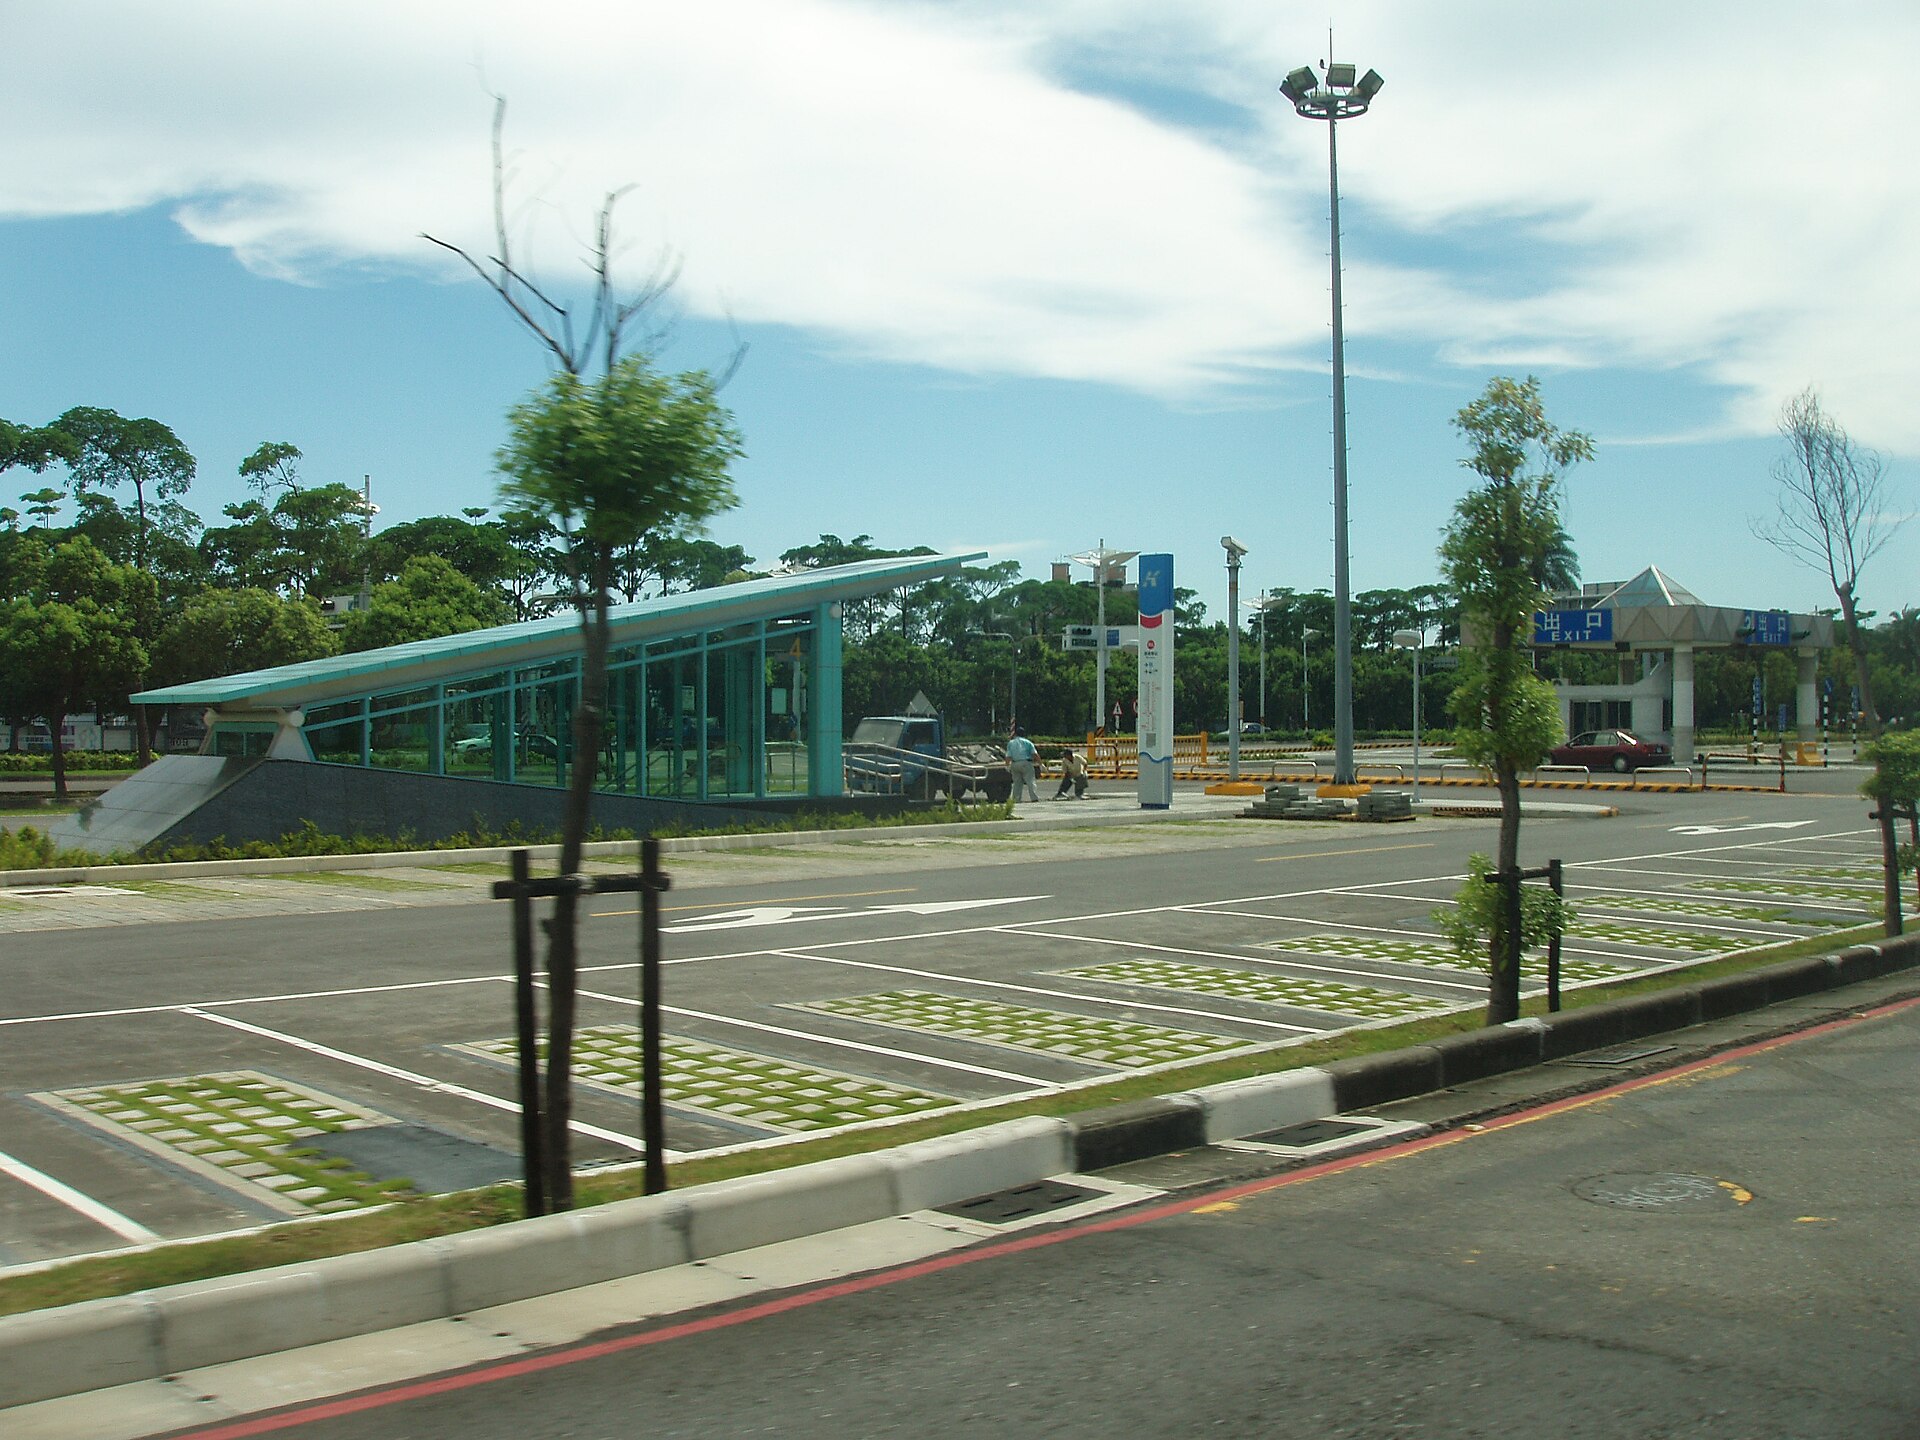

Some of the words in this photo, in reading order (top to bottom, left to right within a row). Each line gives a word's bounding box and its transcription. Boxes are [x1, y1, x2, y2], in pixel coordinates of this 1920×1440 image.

[1544, 612, 1602, 631] 出口
[1551, 630, 1592, 641] EXIT
[1763, 632, 1782, 643] EXIT
